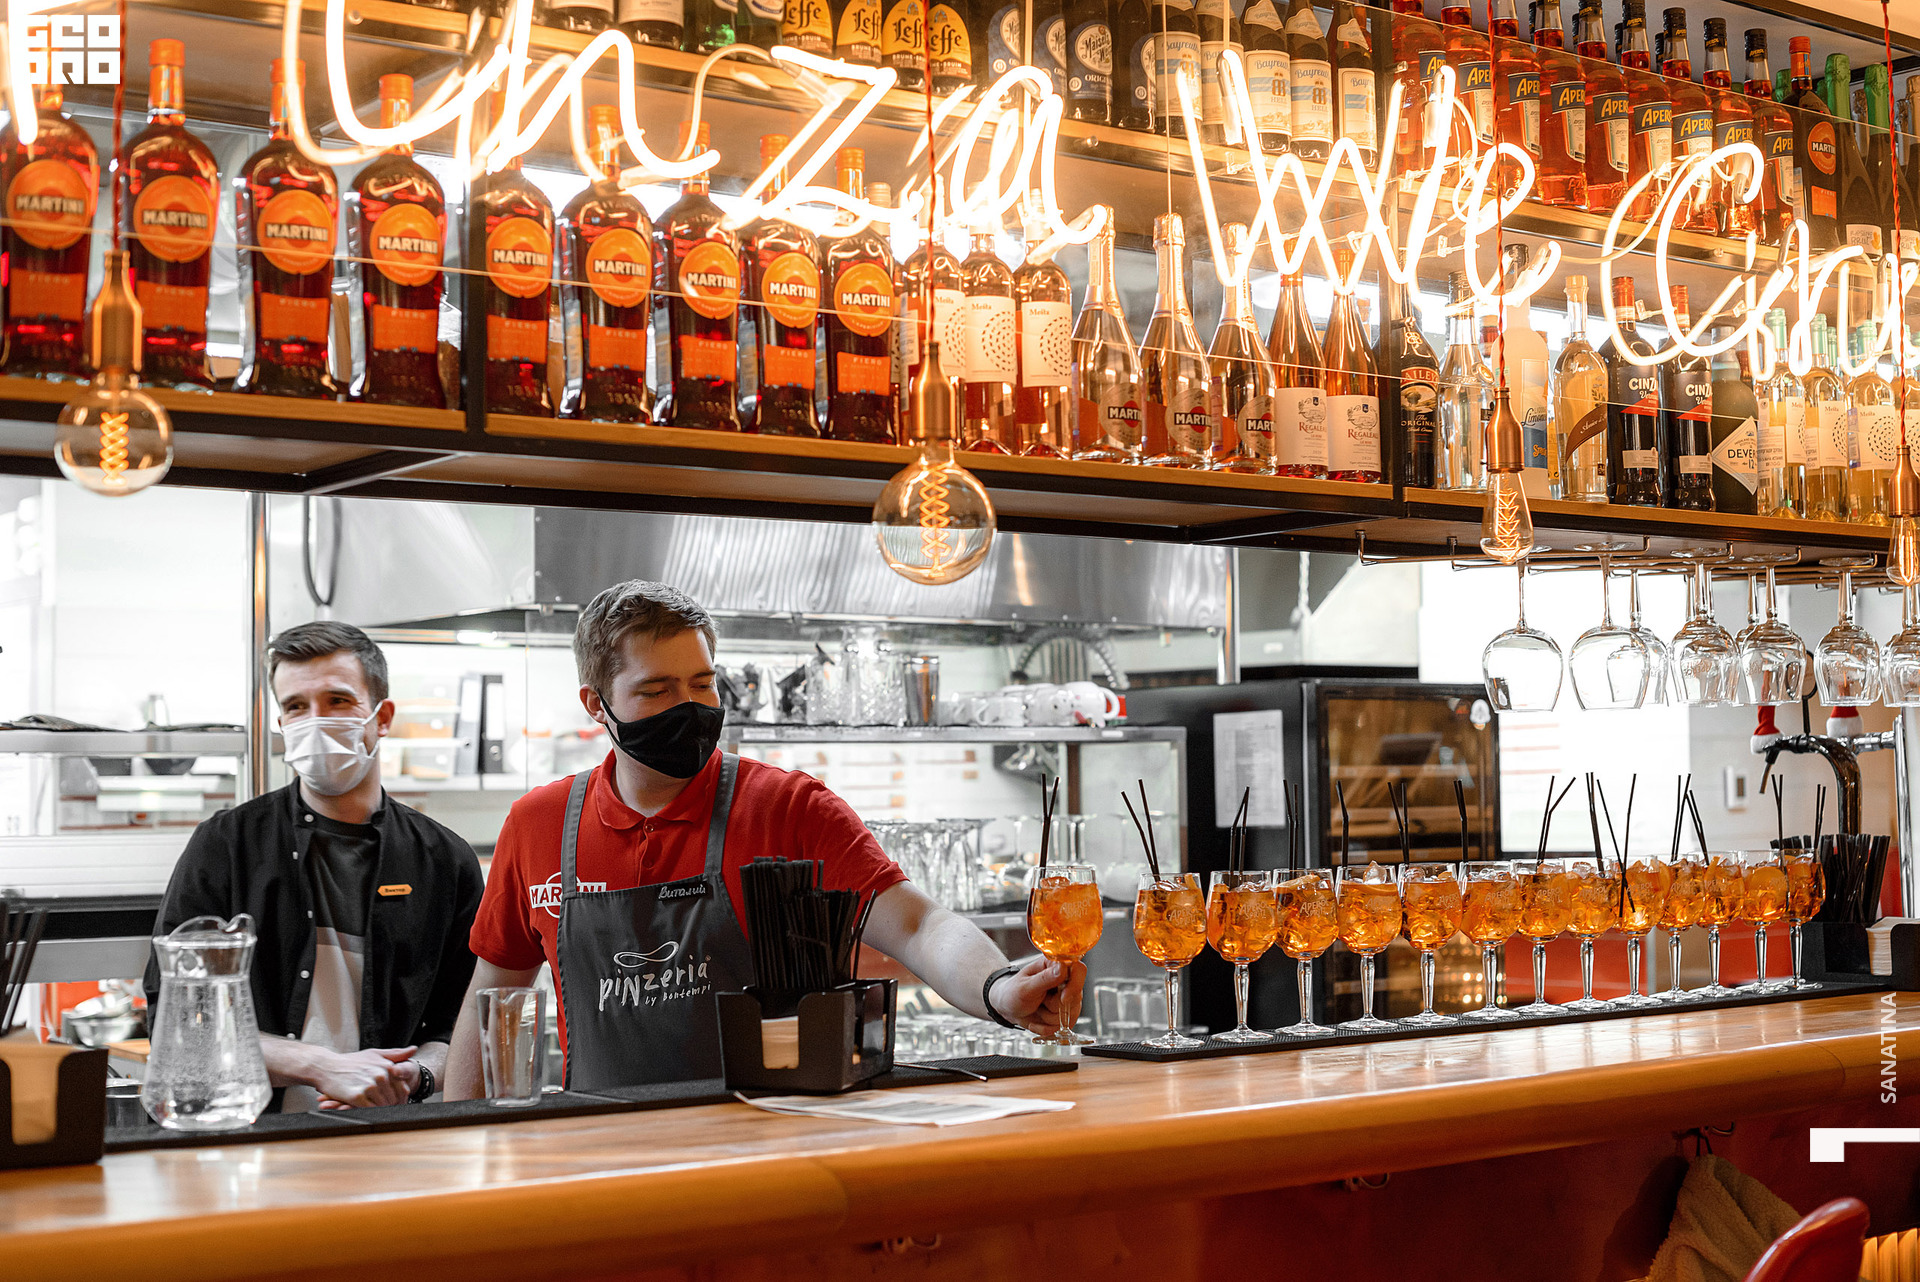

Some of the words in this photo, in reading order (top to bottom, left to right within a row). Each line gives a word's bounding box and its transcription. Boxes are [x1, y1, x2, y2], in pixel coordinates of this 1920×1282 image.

[929, 24, 962, 55] effe
[16, 195, 85, 214] MARTINI
[142, 209, 208, 228] MARTINI
[266, 223, 329, 242] MARTINI
[378, 236, 438, 255] MARTINI
[493, 249, 548, 267] MARTINI
[593, 259, 647, 277] MARTINI
[686, 272, 737, 289] MARTINI
[769, 282, 817, 299] MARTINI
[841, 292, 890, 308] MARTINI
